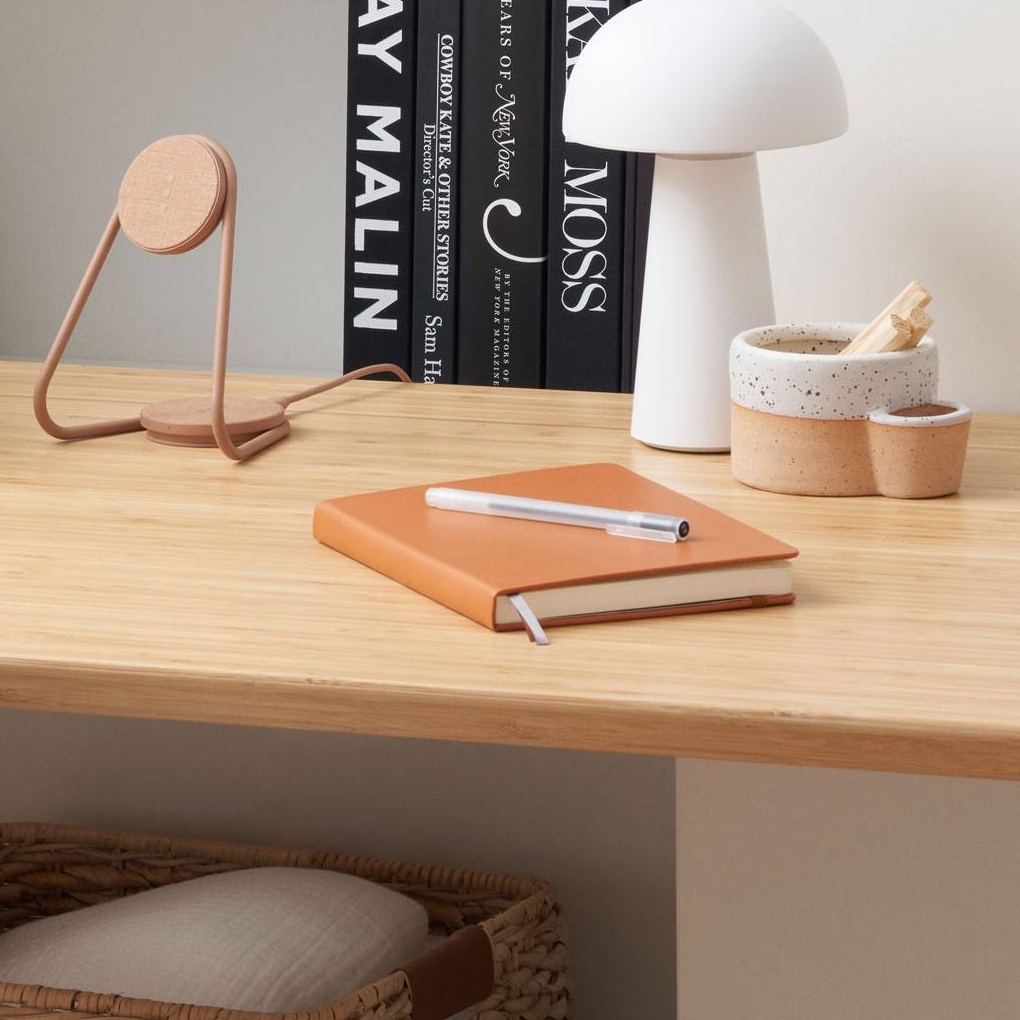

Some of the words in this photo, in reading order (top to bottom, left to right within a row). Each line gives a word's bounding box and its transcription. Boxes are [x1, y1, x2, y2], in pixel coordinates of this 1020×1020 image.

[439, 34, 454, 106] COWBOY
[499, 55, 512, 80] OF
[439, 110, 453, 152] KATE
[422, 123, 436, 185] Director's
[438, 156, 452, 169] &
[352, 104, 402, 331] MALIN
[422, 188, 435, 212] Cut
[437, 173, 451, 230] OTHER
[561, 158, 608, 312] MOSS
[436, 234, 450, 301] STORIES
[503, 273, 510, 286] BY
[493, 296, 501, 323] YORK
[424, 315, 443, 353] Sam
[503, 369, 510, 383] OF
